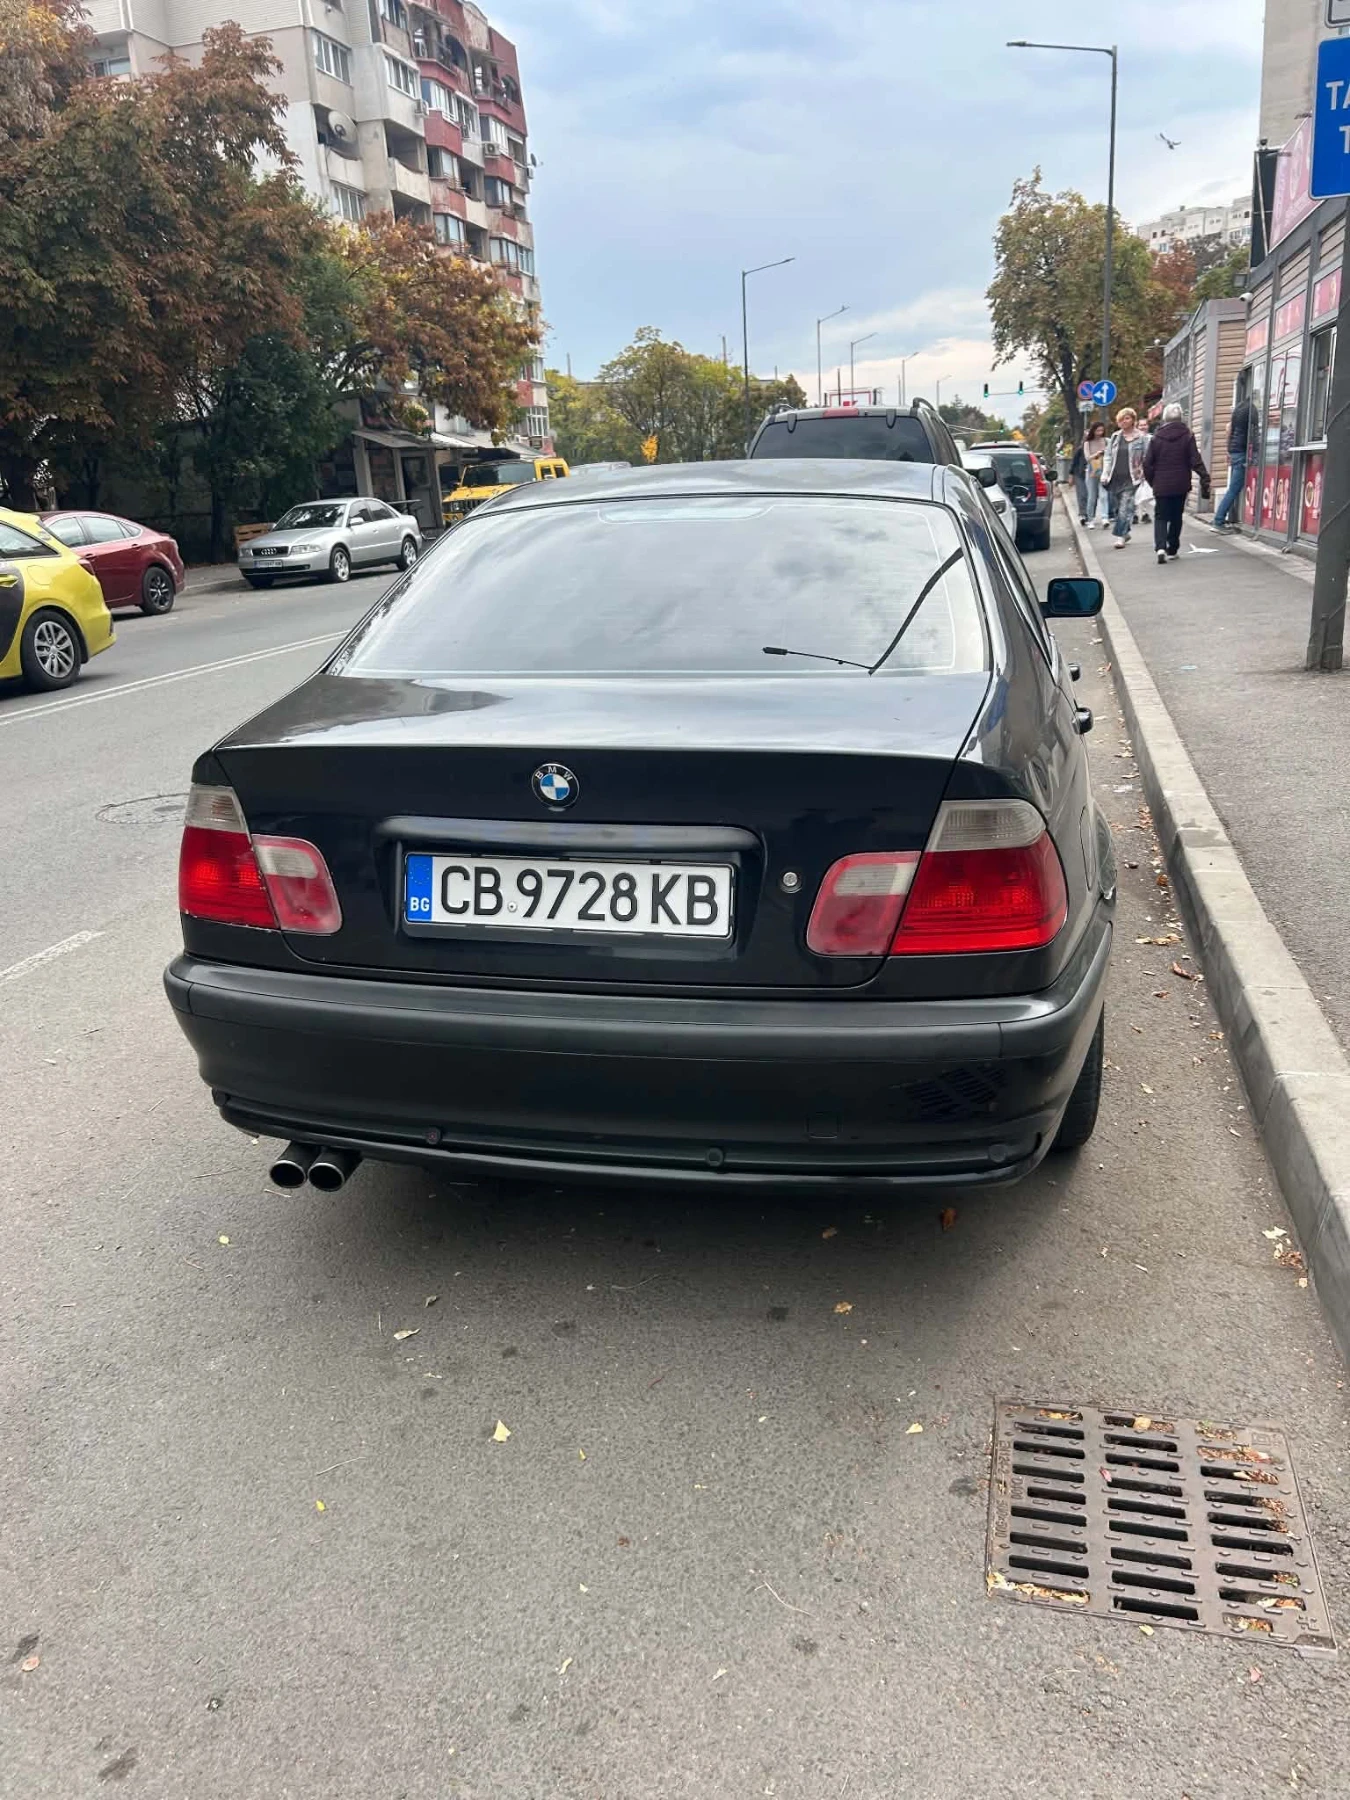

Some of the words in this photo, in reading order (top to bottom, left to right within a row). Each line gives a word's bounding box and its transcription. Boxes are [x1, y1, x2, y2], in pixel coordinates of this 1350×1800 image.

[534, 766, 573, 781] BMW
[441, 865, 503, 915] CB
[516, 868, 638, 922] 9728
[651, 873, 718, 926] KB
[410, 896, 430, 912] BG
